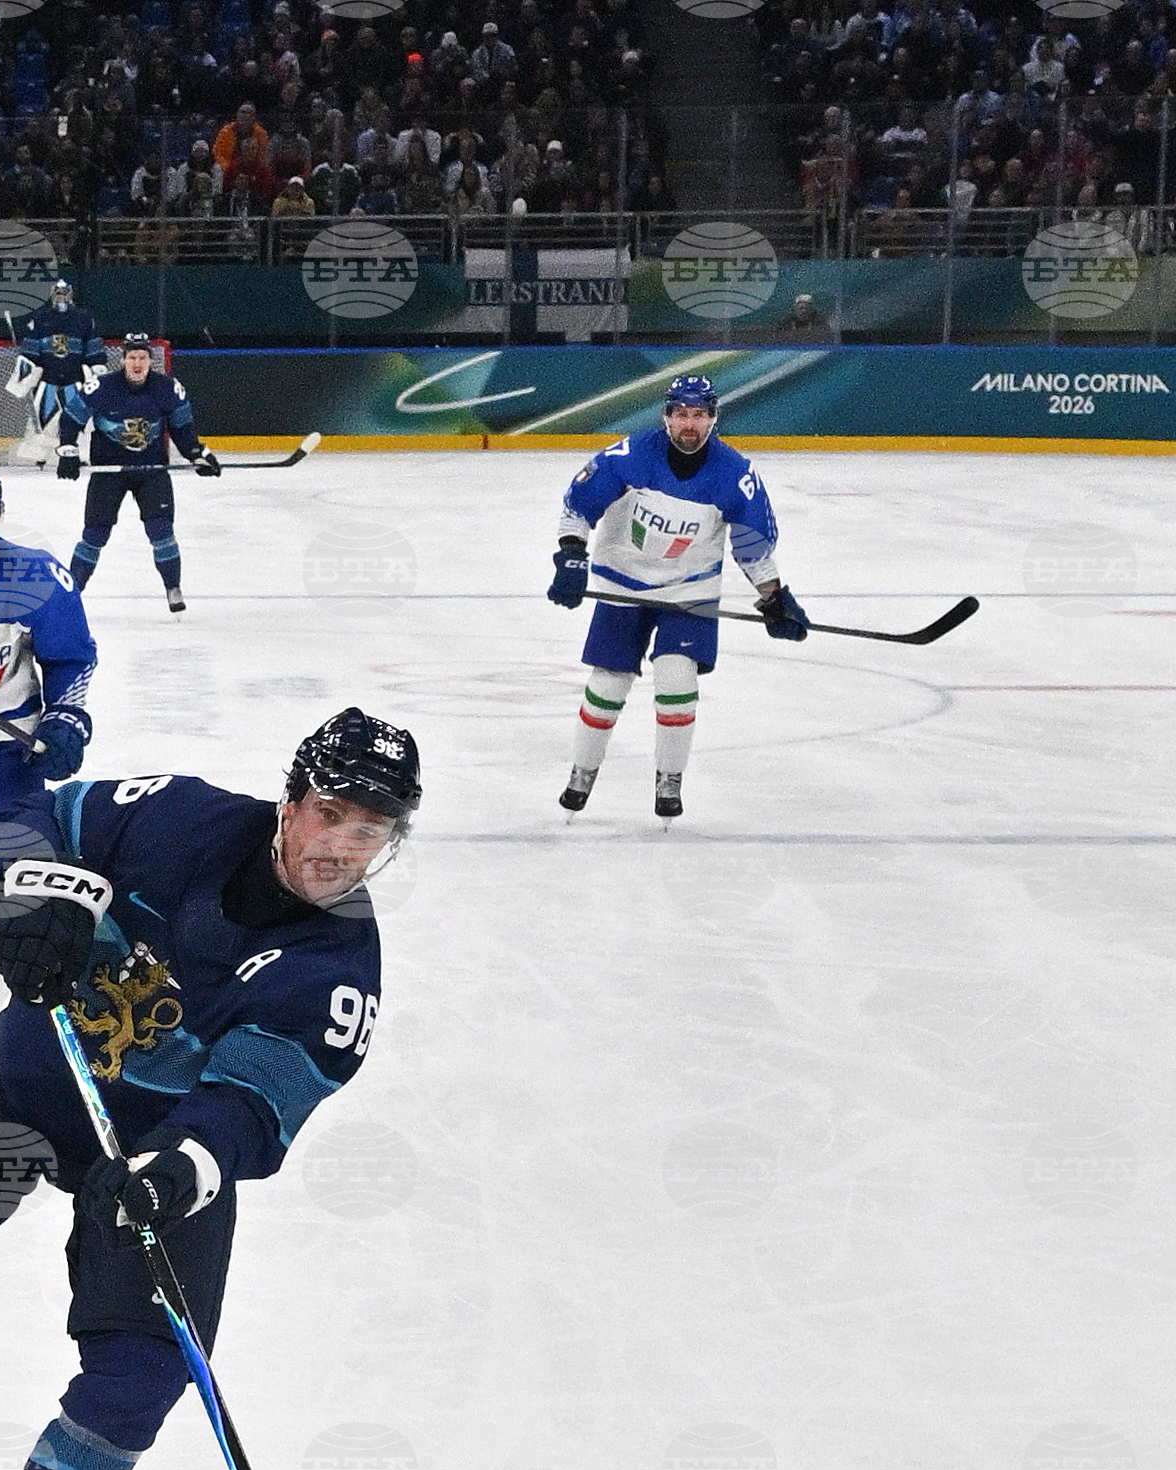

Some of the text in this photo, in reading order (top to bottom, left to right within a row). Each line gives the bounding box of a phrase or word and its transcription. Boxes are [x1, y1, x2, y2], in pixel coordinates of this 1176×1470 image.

[971, 373, 1170, 393] MILANO CORTINA
[1049, 395, 1095, 414] 2026
[633, 502, 701, 536] ITALIA
[15, 870, 106, 903] CCM
[235, 949, 282, 983] A
[142, 1178, 159, 1210] CCM
